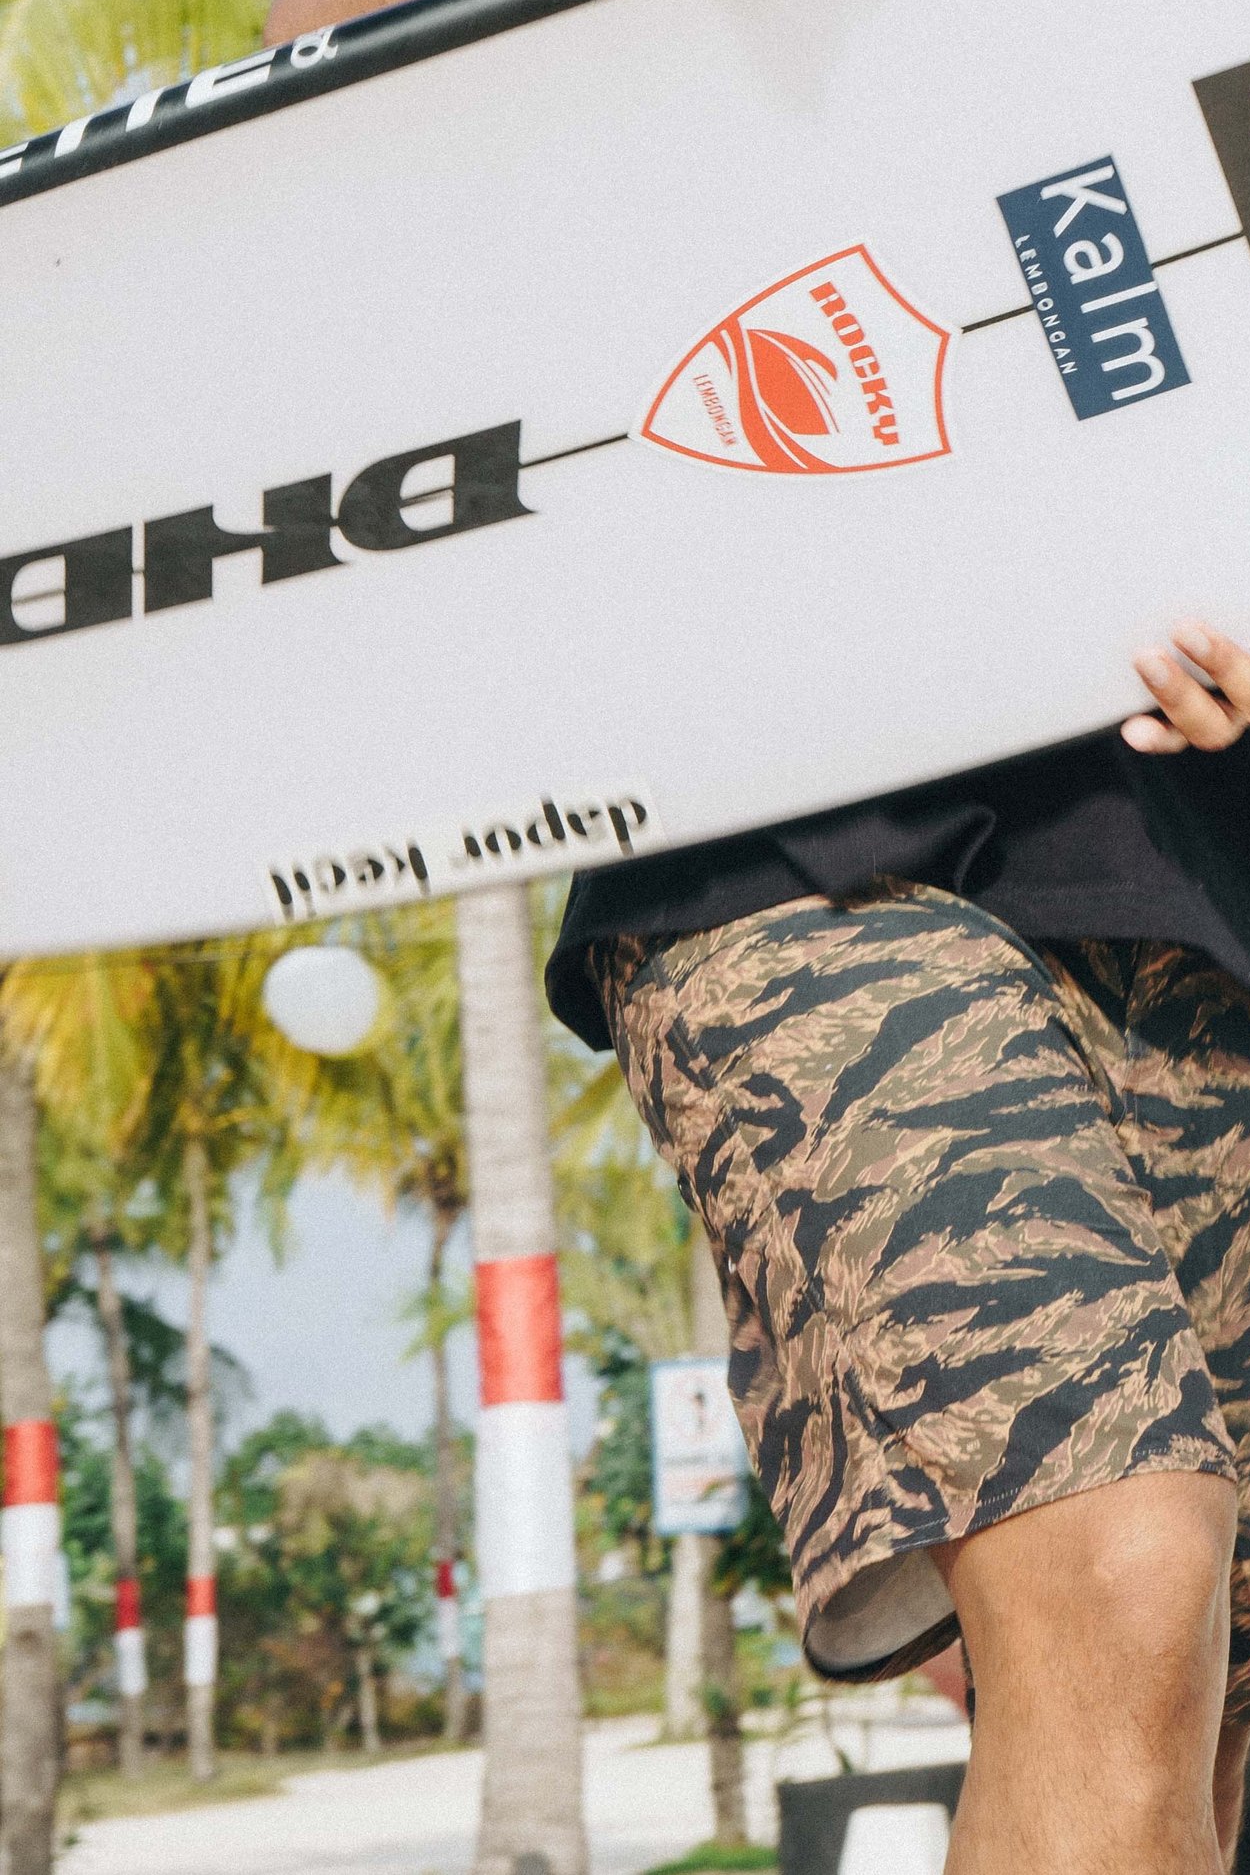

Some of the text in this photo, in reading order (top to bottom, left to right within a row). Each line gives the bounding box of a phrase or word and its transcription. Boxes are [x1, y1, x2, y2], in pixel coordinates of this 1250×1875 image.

[809, 280, 900, 447] ROCKY
[1014, 234, 1078, 375] LEMBONGAN
[1040, 164, 1168, 401] Kalm
[692, 373, 739, 448] LEMBONGAN
[0, 419, 540, 646] DHD
